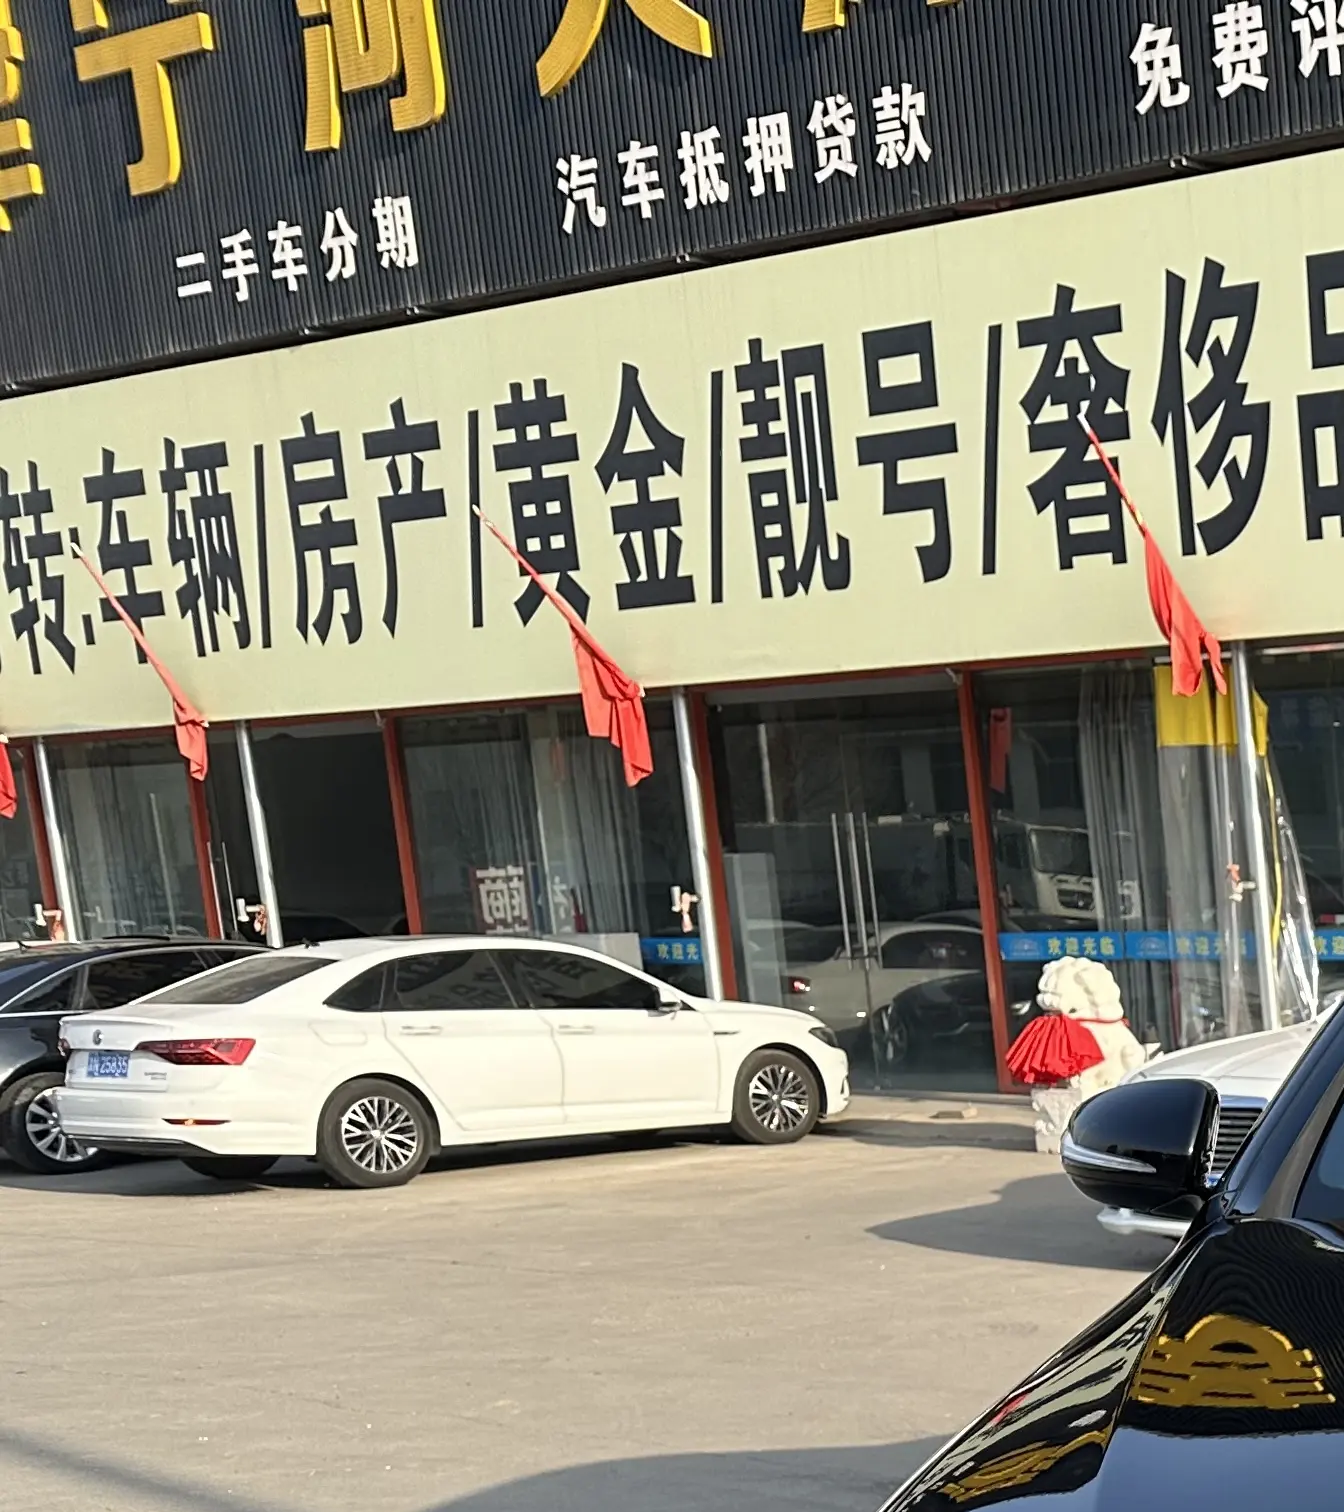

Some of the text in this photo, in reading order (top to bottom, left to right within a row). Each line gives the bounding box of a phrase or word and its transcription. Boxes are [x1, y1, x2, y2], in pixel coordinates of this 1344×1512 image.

[556, 83, 933, 234] 汽车抵押贷款
[176, 196, 420, 303] 二手车分期
[1046, 936, 1115, 955] 欢迎光临
